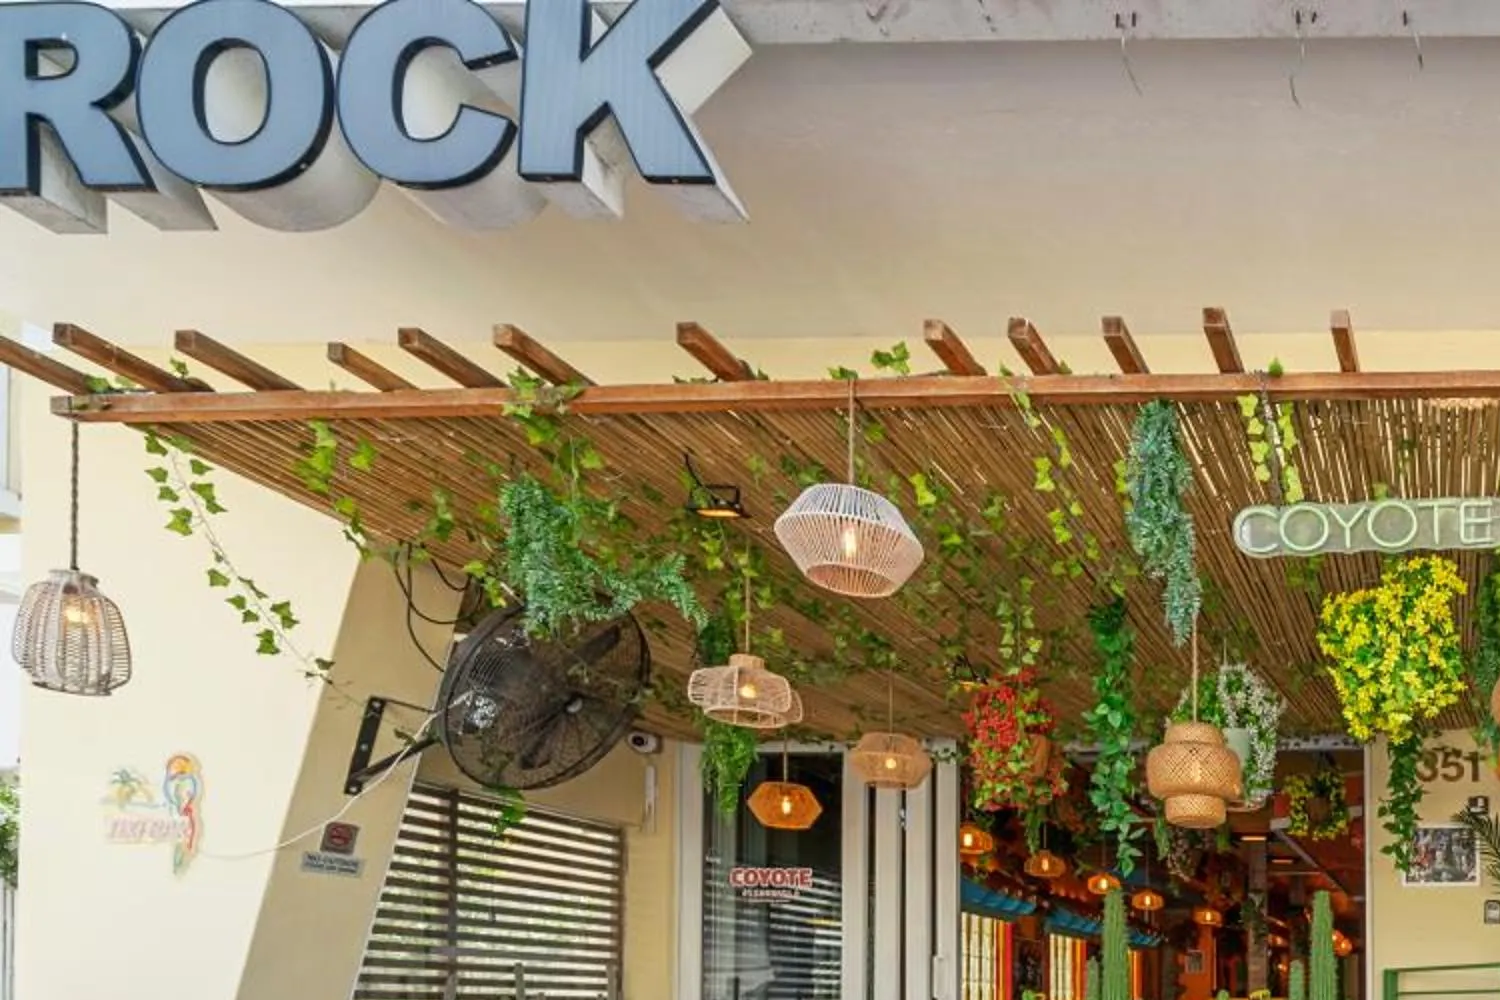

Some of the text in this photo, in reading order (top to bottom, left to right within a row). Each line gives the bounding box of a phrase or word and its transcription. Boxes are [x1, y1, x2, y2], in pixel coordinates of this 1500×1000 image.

[0, 0, 722, 192] ROCK
[1236, 500, 1494, 553] COYOTE
[730, 868, 812, 887] COYOTE
